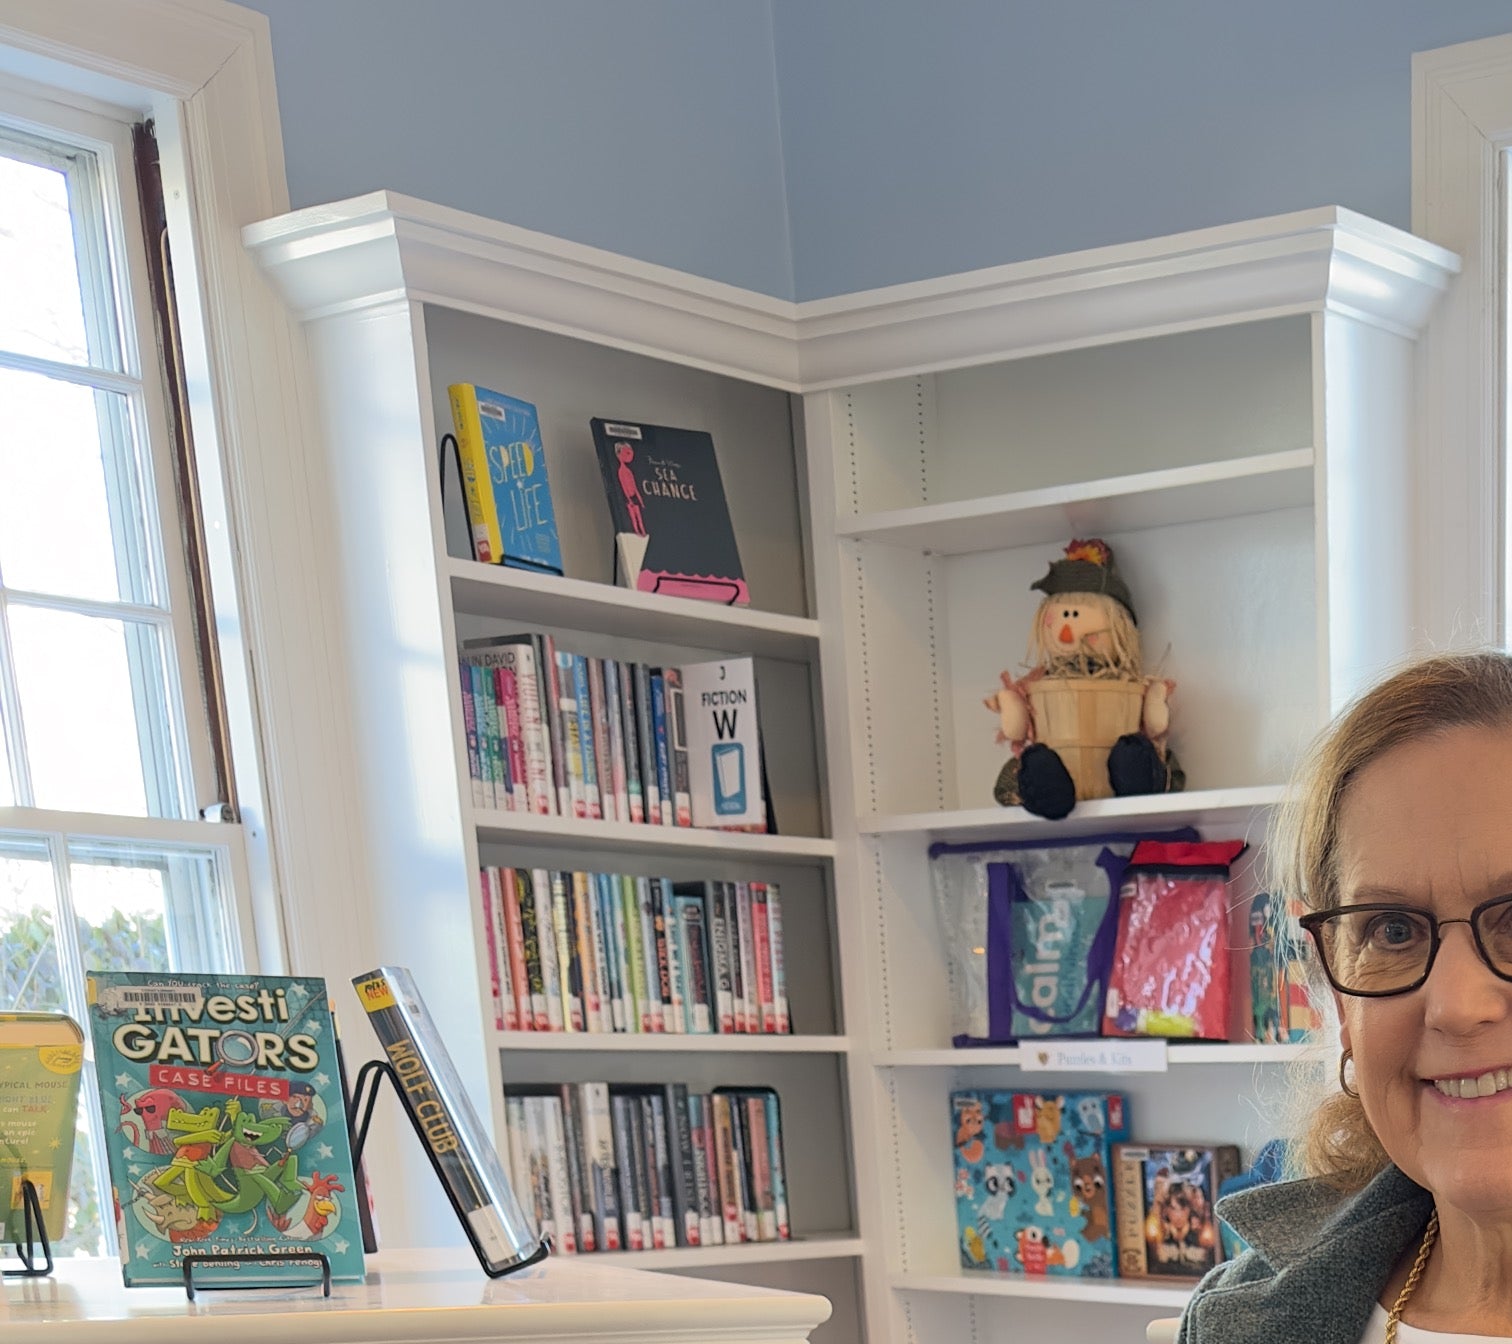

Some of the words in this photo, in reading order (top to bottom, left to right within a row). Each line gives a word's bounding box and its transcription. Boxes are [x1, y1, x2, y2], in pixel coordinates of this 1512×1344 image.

[489, 441, 535, 484] SPEED
[654, 467, 677, 482] SEA
[642, 479, 698, 502] CHANCE
[511, 482, 548, 531] LIFE
[486, 652, 515, 667] DAVID
[701, 690, 747, 706] FICTION
[713, 709, 738, 740] W
[112, 1022, 320, 1073] GATORS
[158, 1070, 213, 1089] CASE
[224, 1077, 282, 1096] FILES
[386, 1040, 433, 1097] WOLF
[415, 1099, 458, 1155] CLUB
[173, 1245, 206, 1257] John
[211, 1244, 265, 1256] Patrick
[268, 1244, 313, 1254] Green
